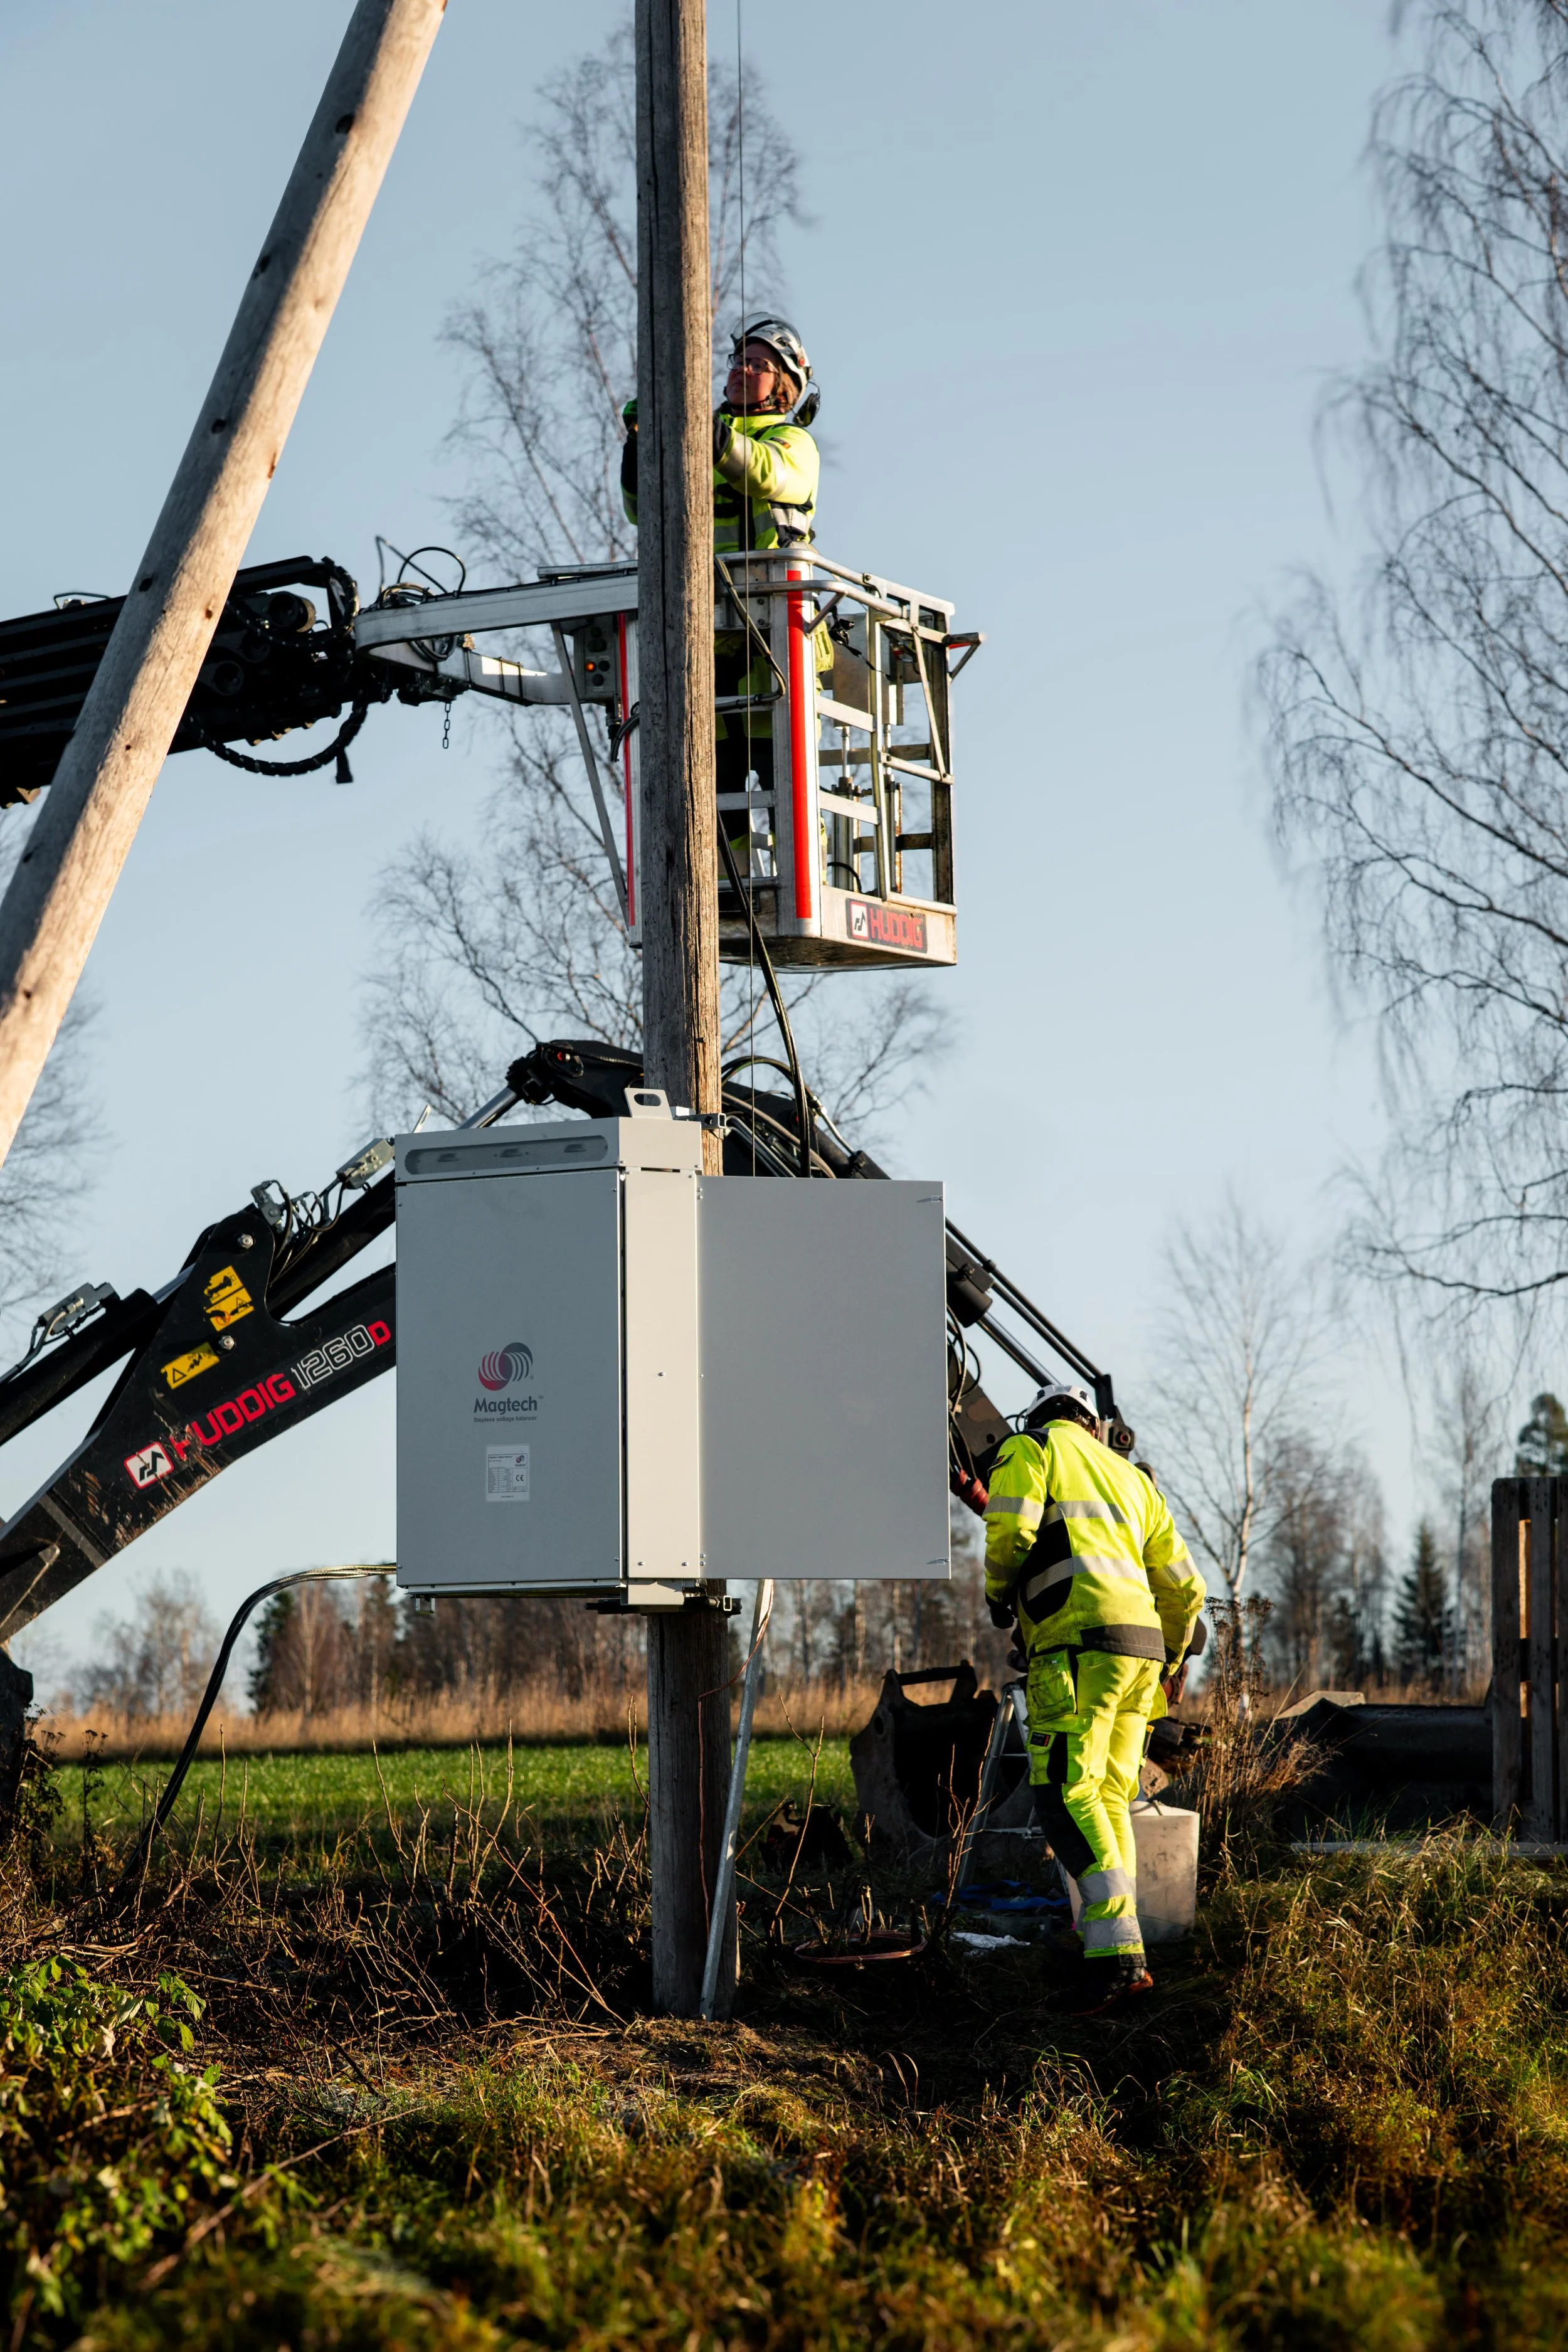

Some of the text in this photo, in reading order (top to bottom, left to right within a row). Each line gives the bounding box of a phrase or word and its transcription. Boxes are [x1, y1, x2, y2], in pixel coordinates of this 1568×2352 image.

[870, 908, 923, 948] HUDDIG
[169, 1373, 296, 1461] HUDDIG
[474, 1396, 538, 1415] Magtech
